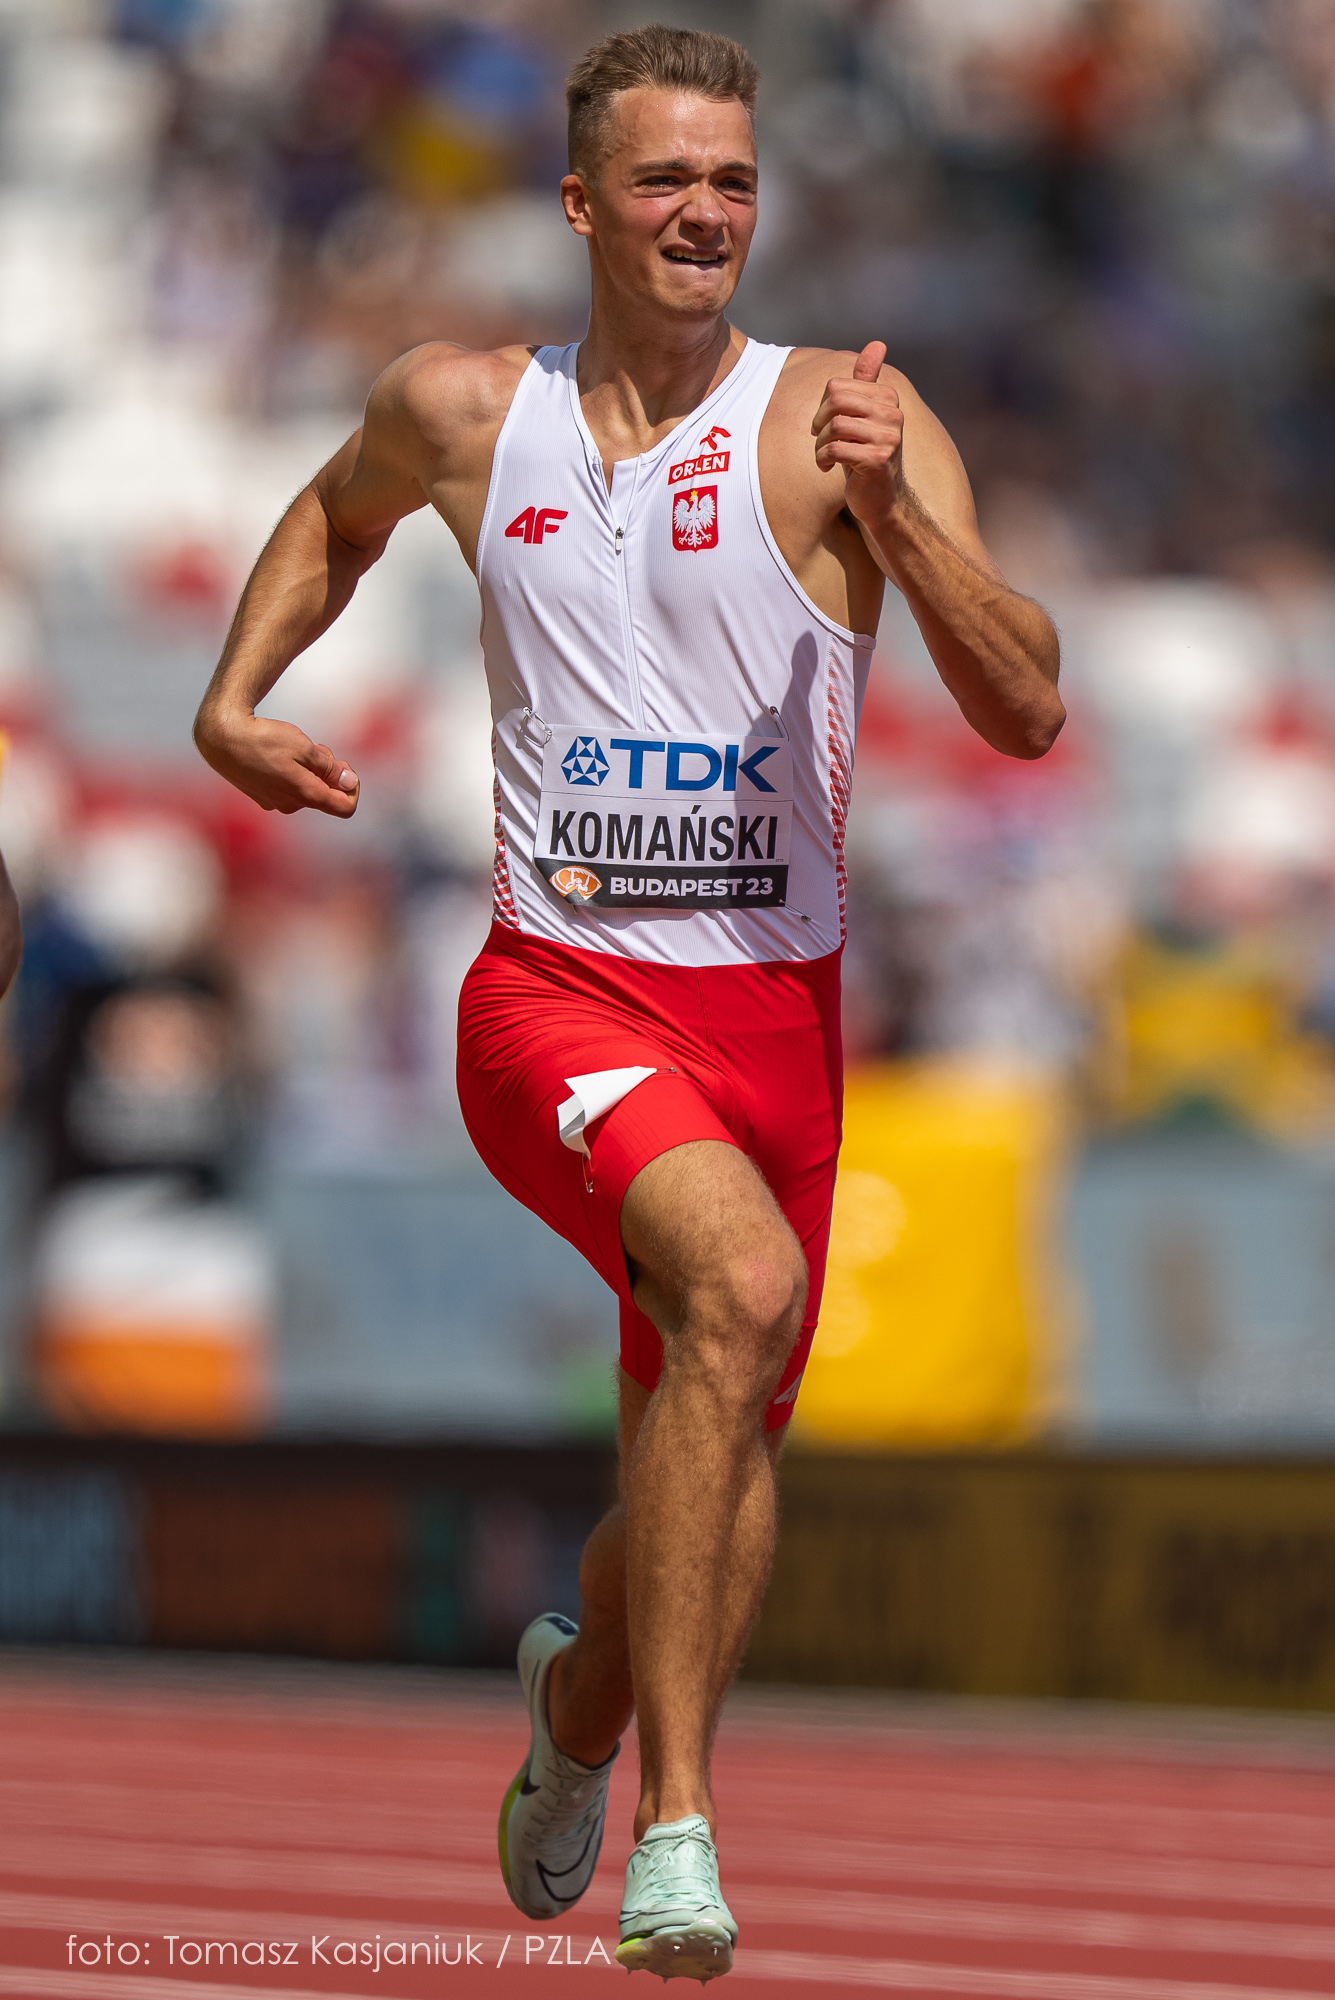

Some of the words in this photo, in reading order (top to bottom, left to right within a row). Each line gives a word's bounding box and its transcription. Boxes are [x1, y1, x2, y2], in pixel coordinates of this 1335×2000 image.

[671, 454, 726, 481] ORLEN
[504, 506, 569, 544] 4F
[610, 738, 781, 793] TDK
[549, 805, 778, 862] KOMAŃSKI
[610, 876, 742, 897] BUDAPEST
[746, 877, 774, 896] 23
